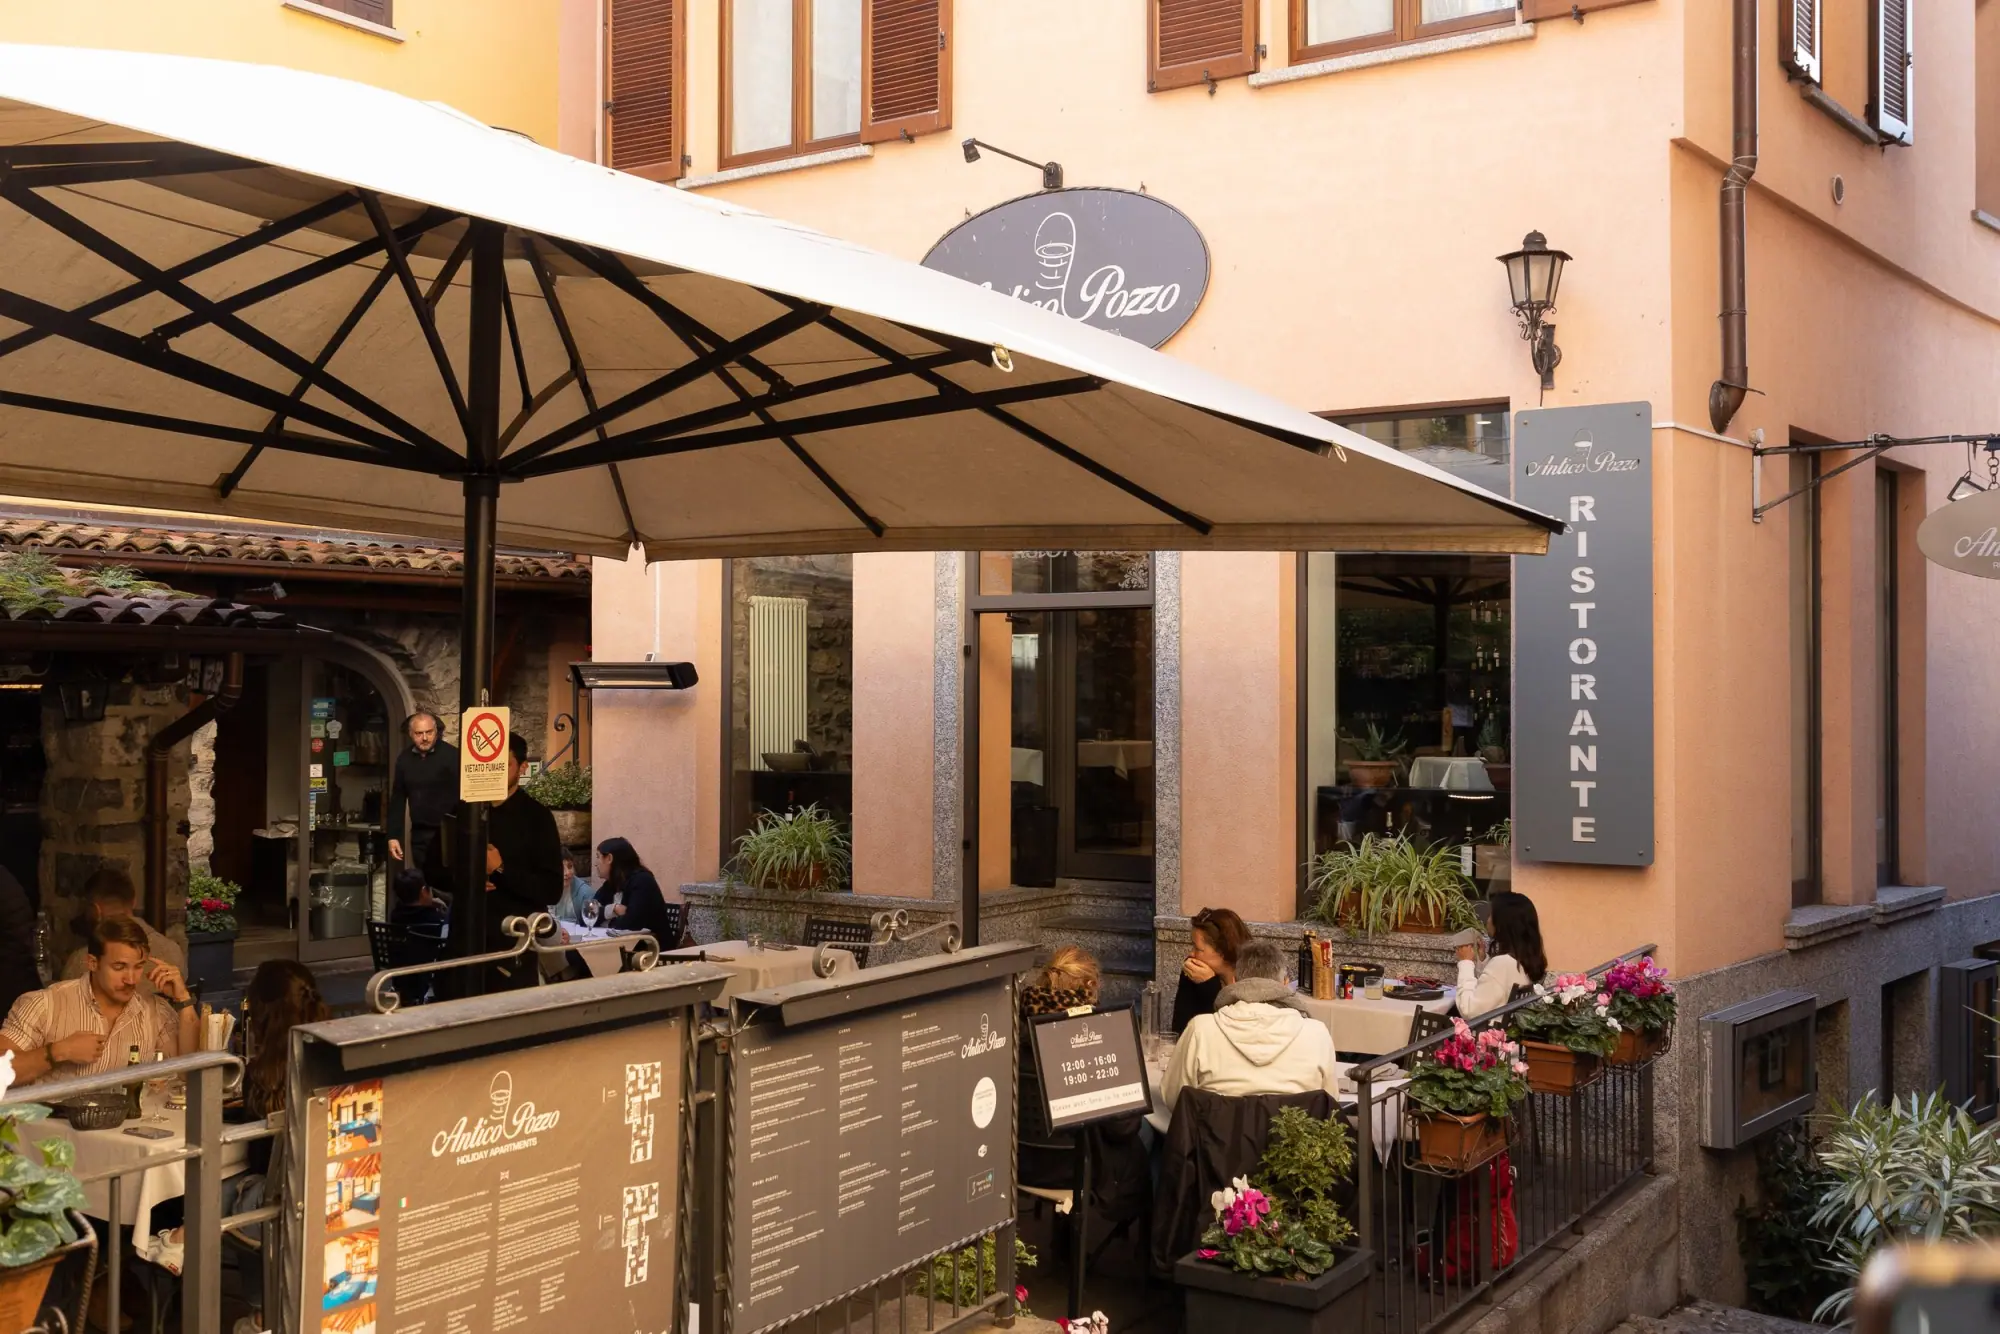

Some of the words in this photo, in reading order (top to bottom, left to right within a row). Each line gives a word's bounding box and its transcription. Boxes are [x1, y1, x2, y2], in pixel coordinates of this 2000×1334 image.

[1064, 264, 1181, 322] Pozzo
[1526, 454, 1586, 477] Antico
[1588, 450, 1640, 473] Pozzo
[1992, 561, 2000, 570] R
[1568, 494, 1598, 844] RISTORANTE
[464, 763, 486, 774] VIETATO
[485, 762, 506, 773] FUMARE
[961, 1036, 988, 1060] Antico
[986, 1029, 1007, 1052] Pozzo
[1061, 1059, 1086, 1073] 12:00
[1093, 1053, 1117, 1067] 16:00
[1063, 1072, 1088, 1086] 19:00
[1095, 1066, 1120, 1080] 22:00
[431, 1116, 503, 1157] Antico
[503, 1101, 560, 1140] Pozzo
[456, 1150, 489, 1166] HOLIDAY
[489, 1137, 538, 1157] APARTMENTS
